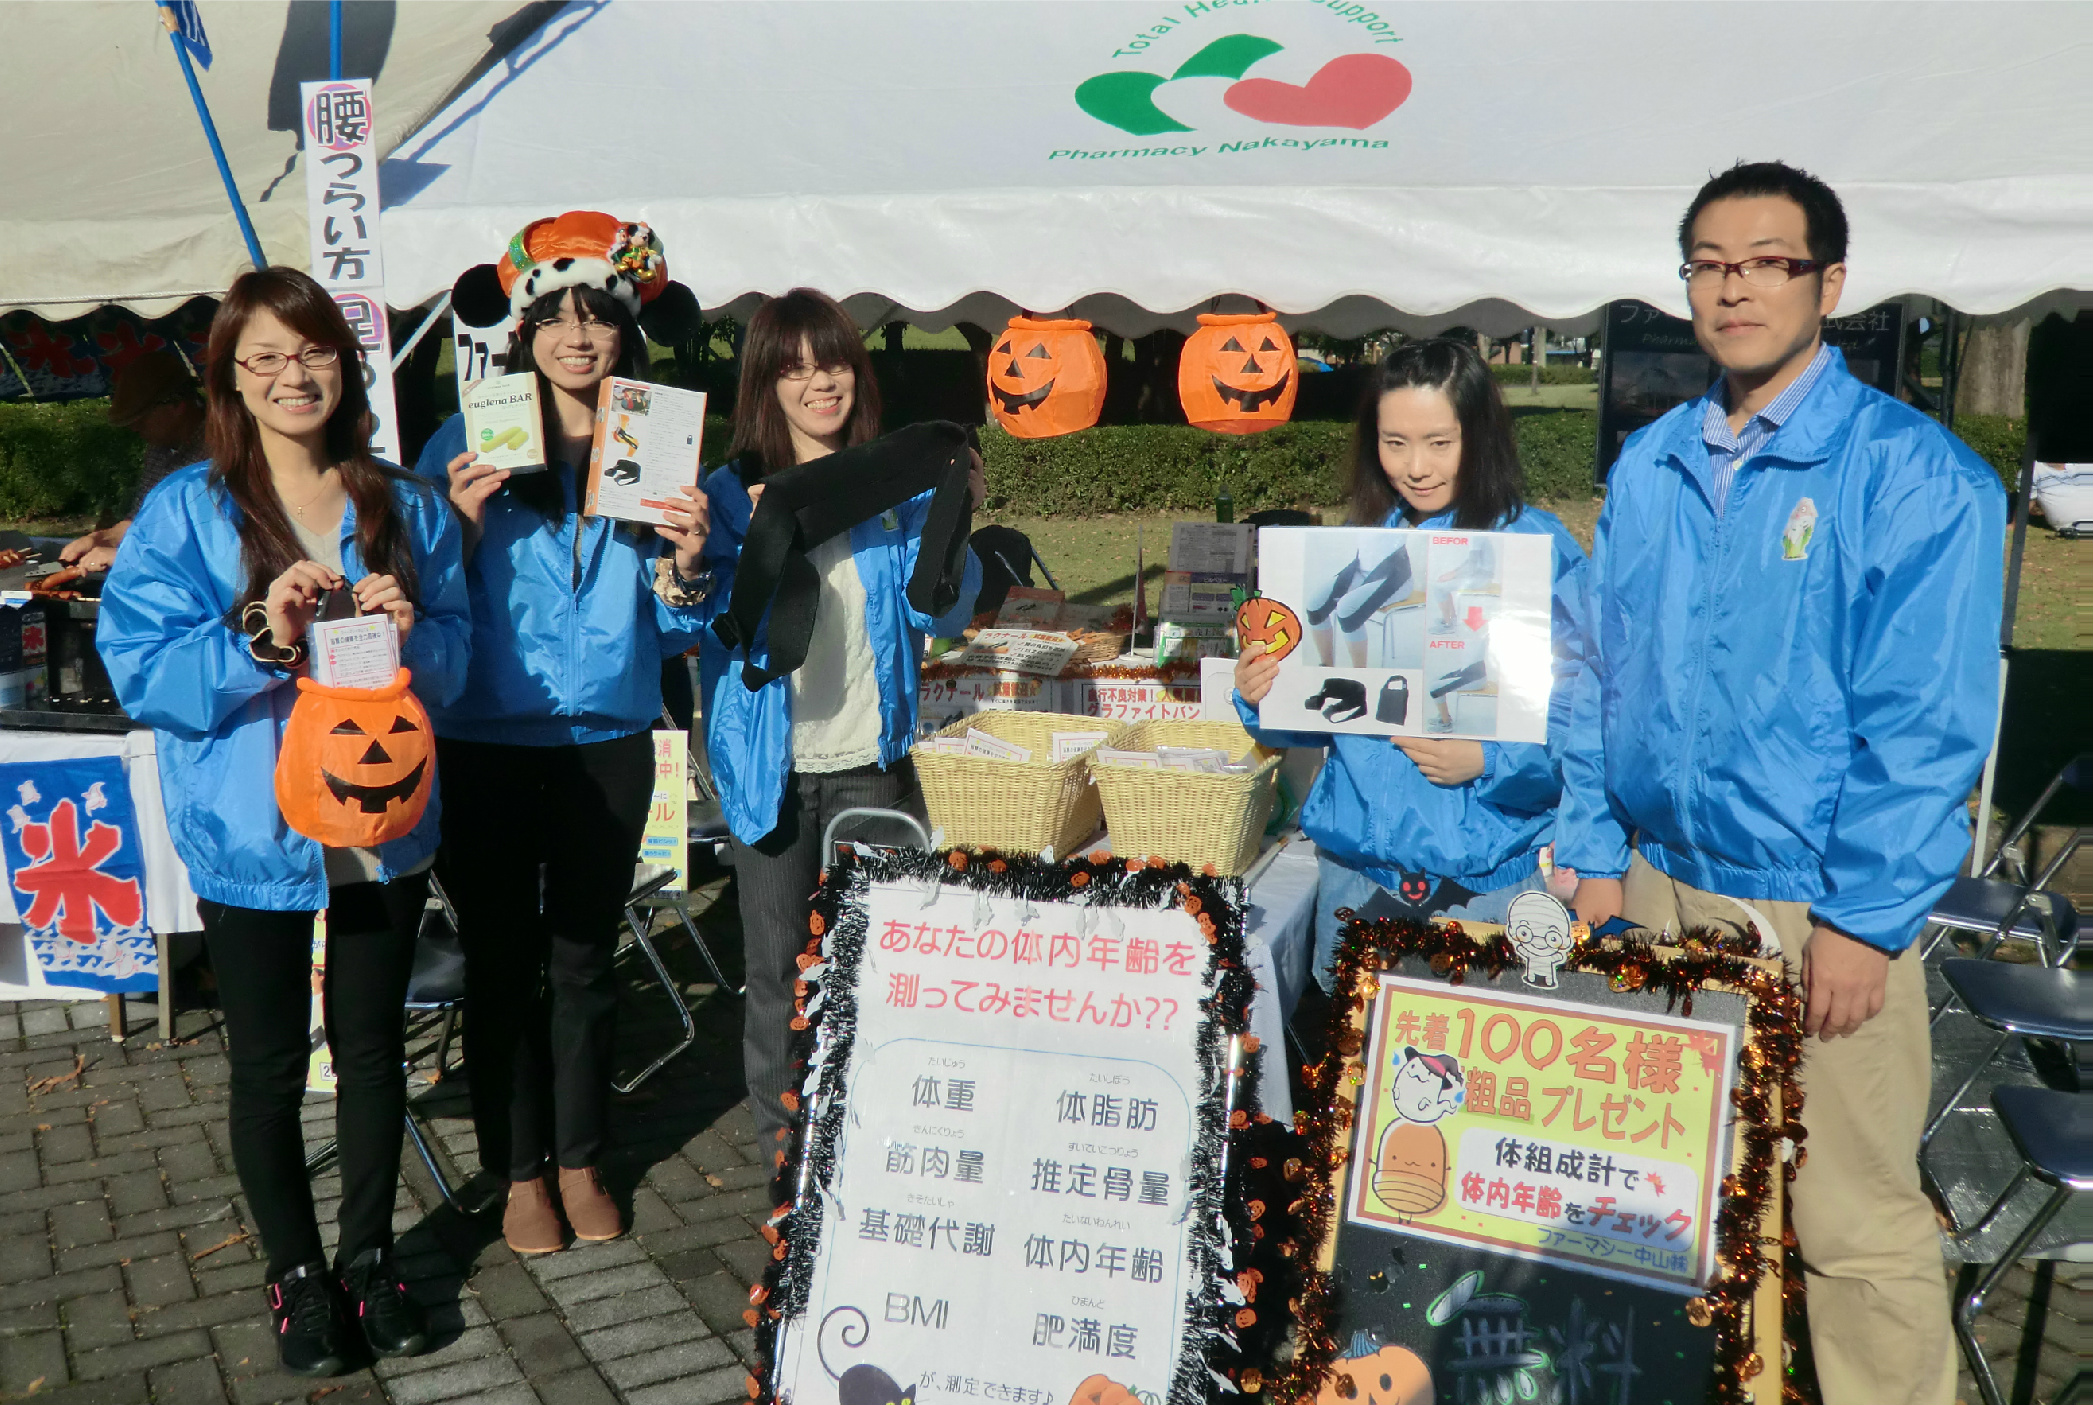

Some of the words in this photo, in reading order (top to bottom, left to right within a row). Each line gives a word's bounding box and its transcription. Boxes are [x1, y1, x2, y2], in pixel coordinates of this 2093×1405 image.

[1111, 16, 1181, 58] Total
[1048, 145, 1207, 161] Pharmacy
[1218, 137, 1390, 154] Nakayama
[316, 90, 371, 280] 腰つらい方
[468, 396, 507, 410] euglena
[509, 393, 532, 405] BAR
[1432, 536, 1469, 546] BEFOR
[1429, 640, 1466, 650] AFTER
[14, 797, 144, 944] 氷
[879, 918, 1197, 977] あなたの体内年齢を
[927, 1056, 966, 1070] たいじゅう
[1088, 1072, 1131, 1085] たいしぼう
[911, 1073, 976, 1113] 体重
[1056, 1089, 1159, 1132] 体脂肪
[1459, 1066, 1686, 1150] 粗品プレゼント
[885, 1140, 985, 1184] 筋肉量
[1030, 1157, 1171, 1207] 推定骨量
[1494, 1136, 1640, 1191] 体組成計で
[1459, 1170, 1693, 1242] 体内年齢をチェック
[858, 1207, 996, 1258] 基礎代謝
[1023, 1233, 1165, 1284] 体内年齢
[884, 1292, 950, 1330] BMI
[1071, 1294, 1106, 1310] ひまんど
[1032, 1313, 1139, 1360] 肥満度
